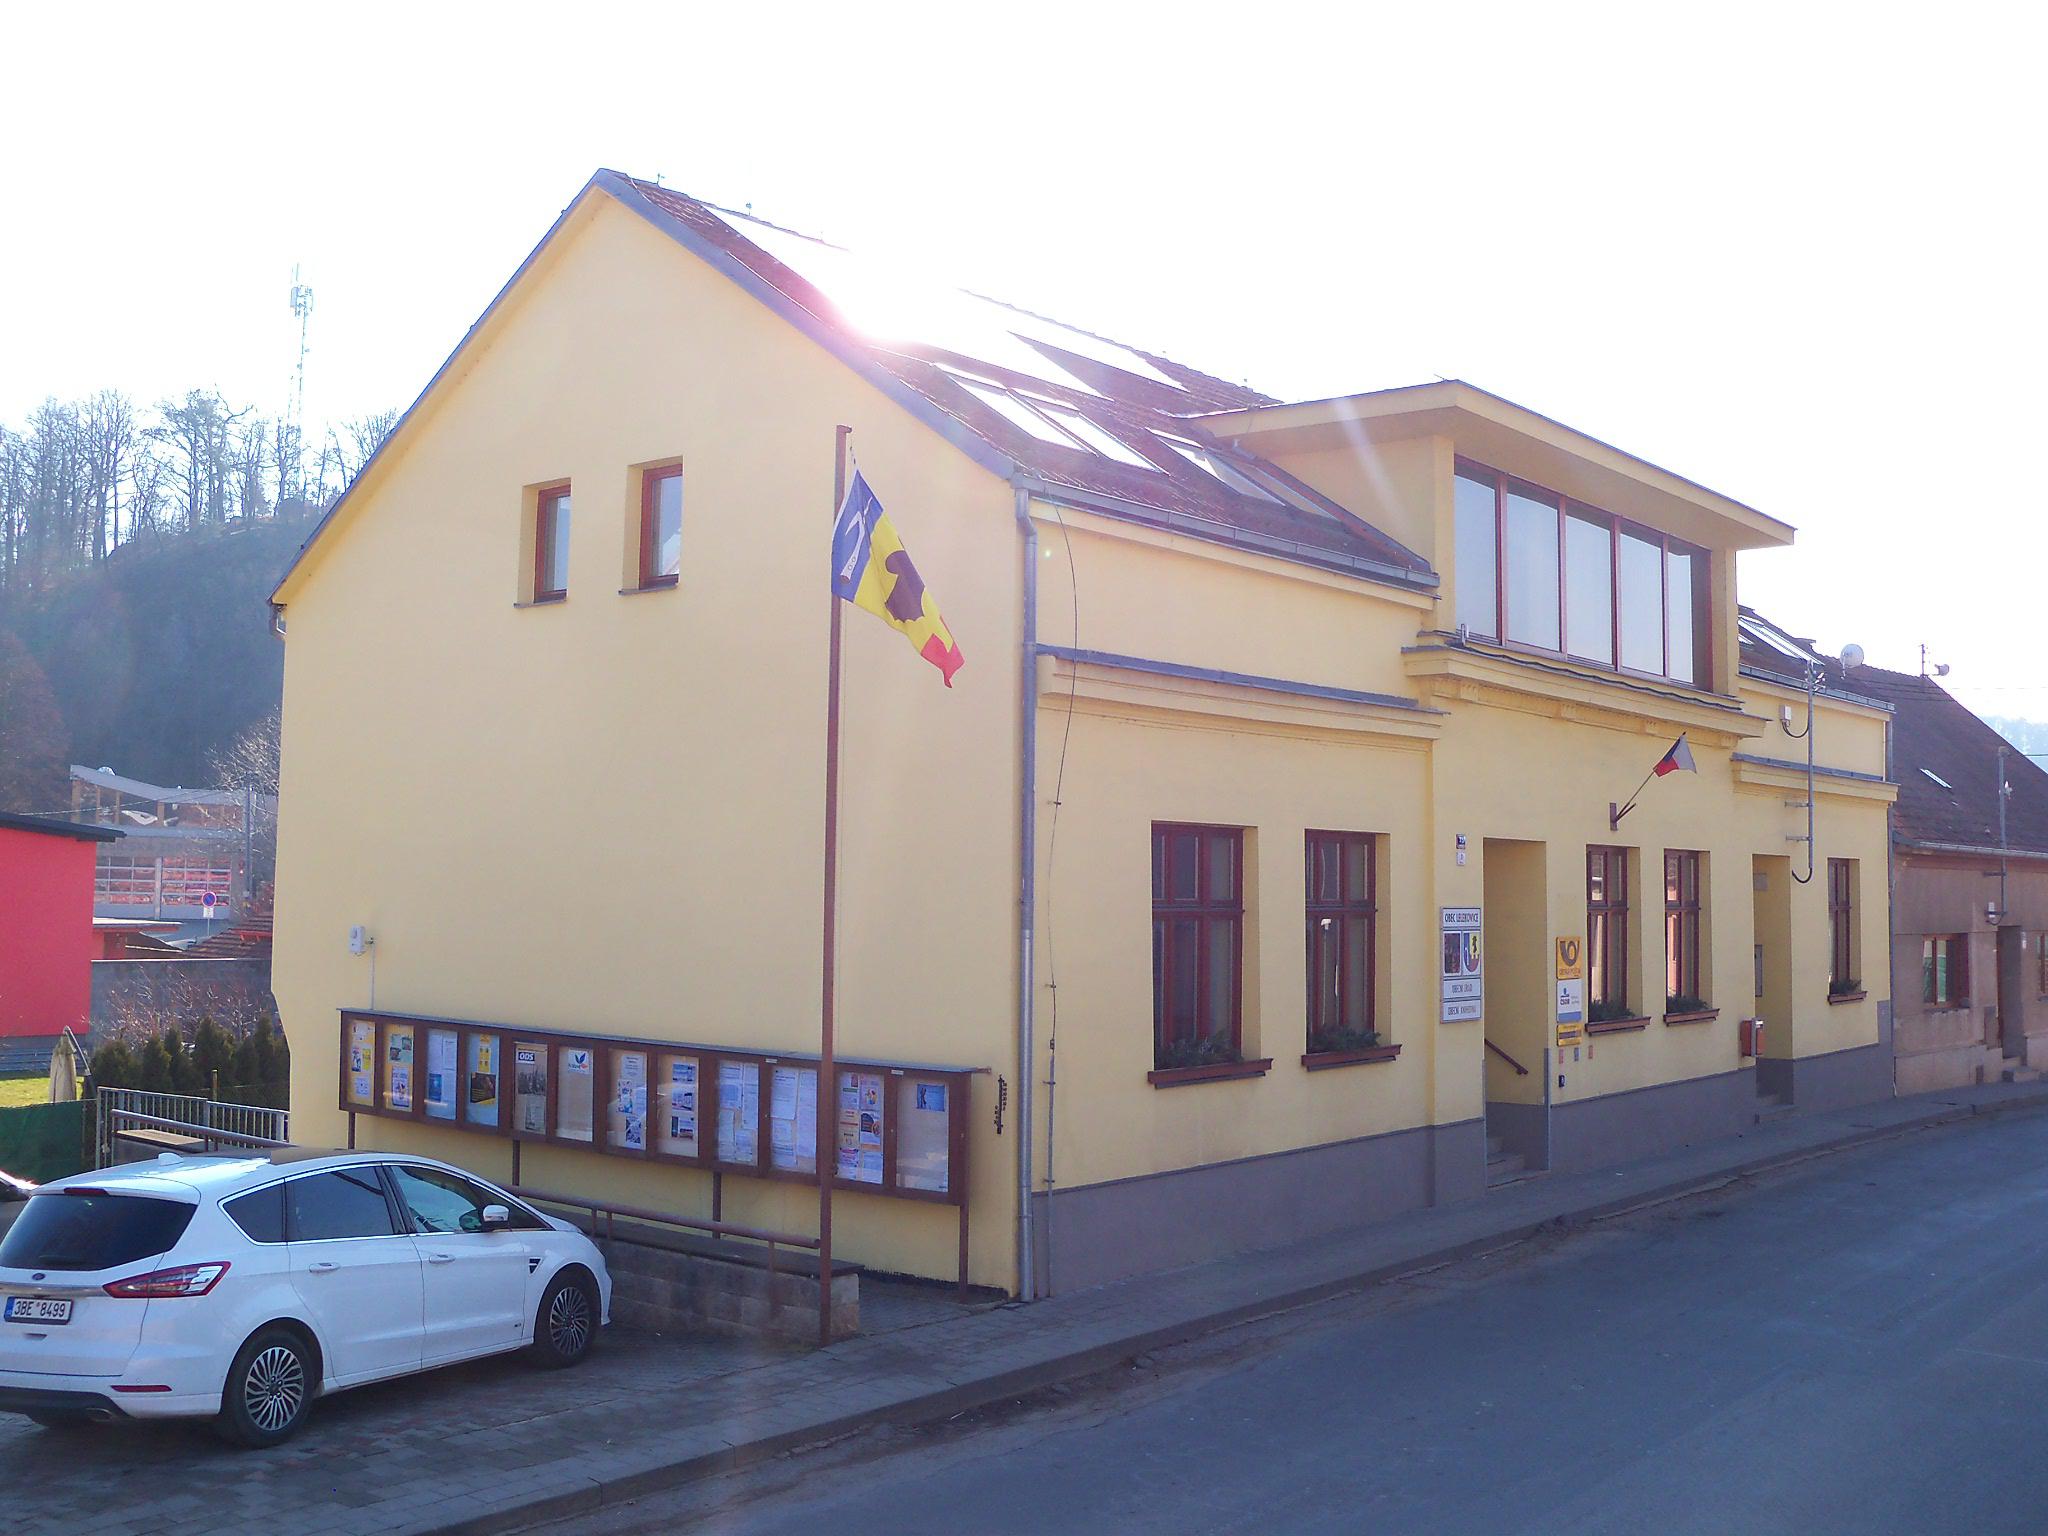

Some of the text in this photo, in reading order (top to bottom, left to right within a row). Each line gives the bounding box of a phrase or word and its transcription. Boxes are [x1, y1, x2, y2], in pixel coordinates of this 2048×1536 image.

[1445, 913, 1456, 922] OBEC
[14, 1301, 65, 1317] 3BE 8499
